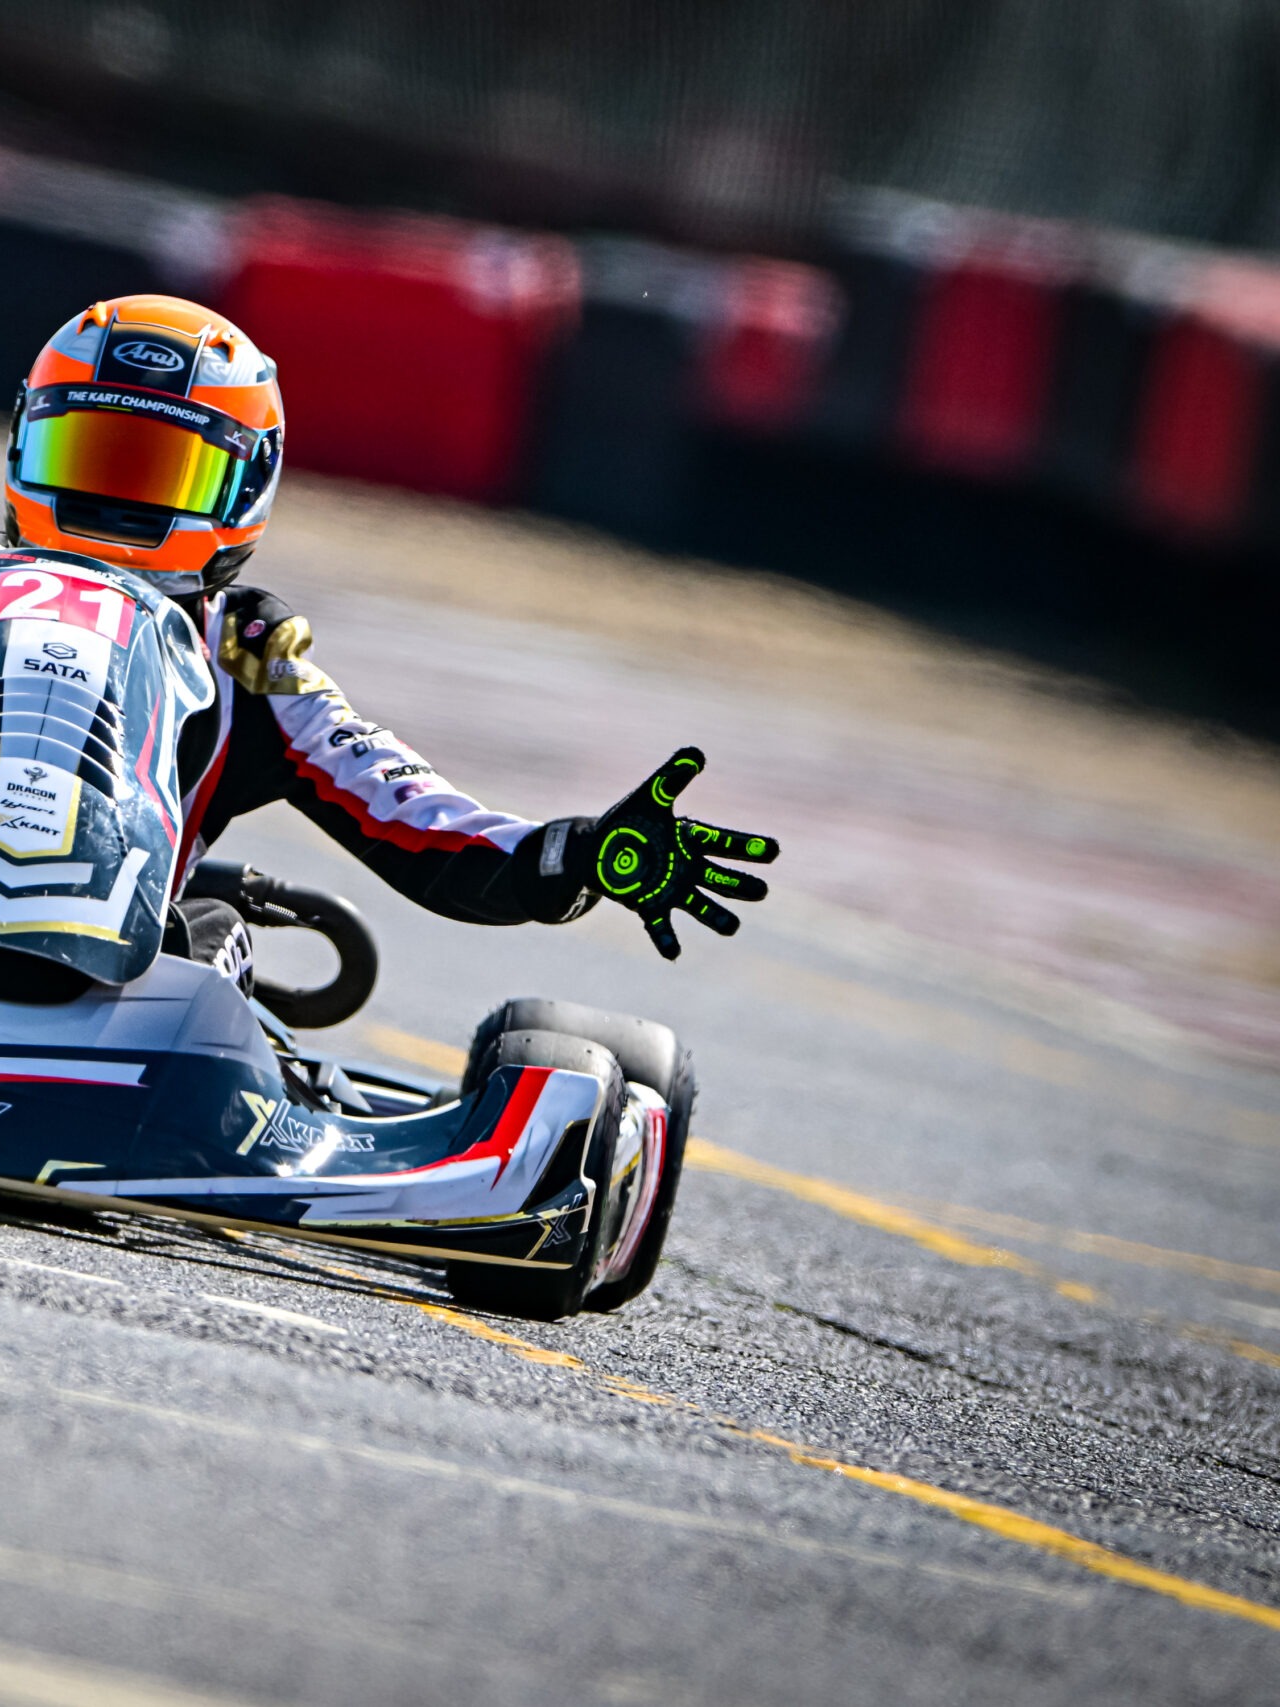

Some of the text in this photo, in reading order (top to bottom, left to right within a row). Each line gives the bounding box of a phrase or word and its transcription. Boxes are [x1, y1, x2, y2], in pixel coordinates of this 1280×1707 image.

[119, 344, 176, 367] Arai
[67, 391, 210, 425] THE KART CHAMPIONSHIP
[1, 570, 128, 640] 21
[23, 658, 88, 682] SATA
[7, 782, 56, 800] DRAGON
[705, 867, 740, 887] freem
